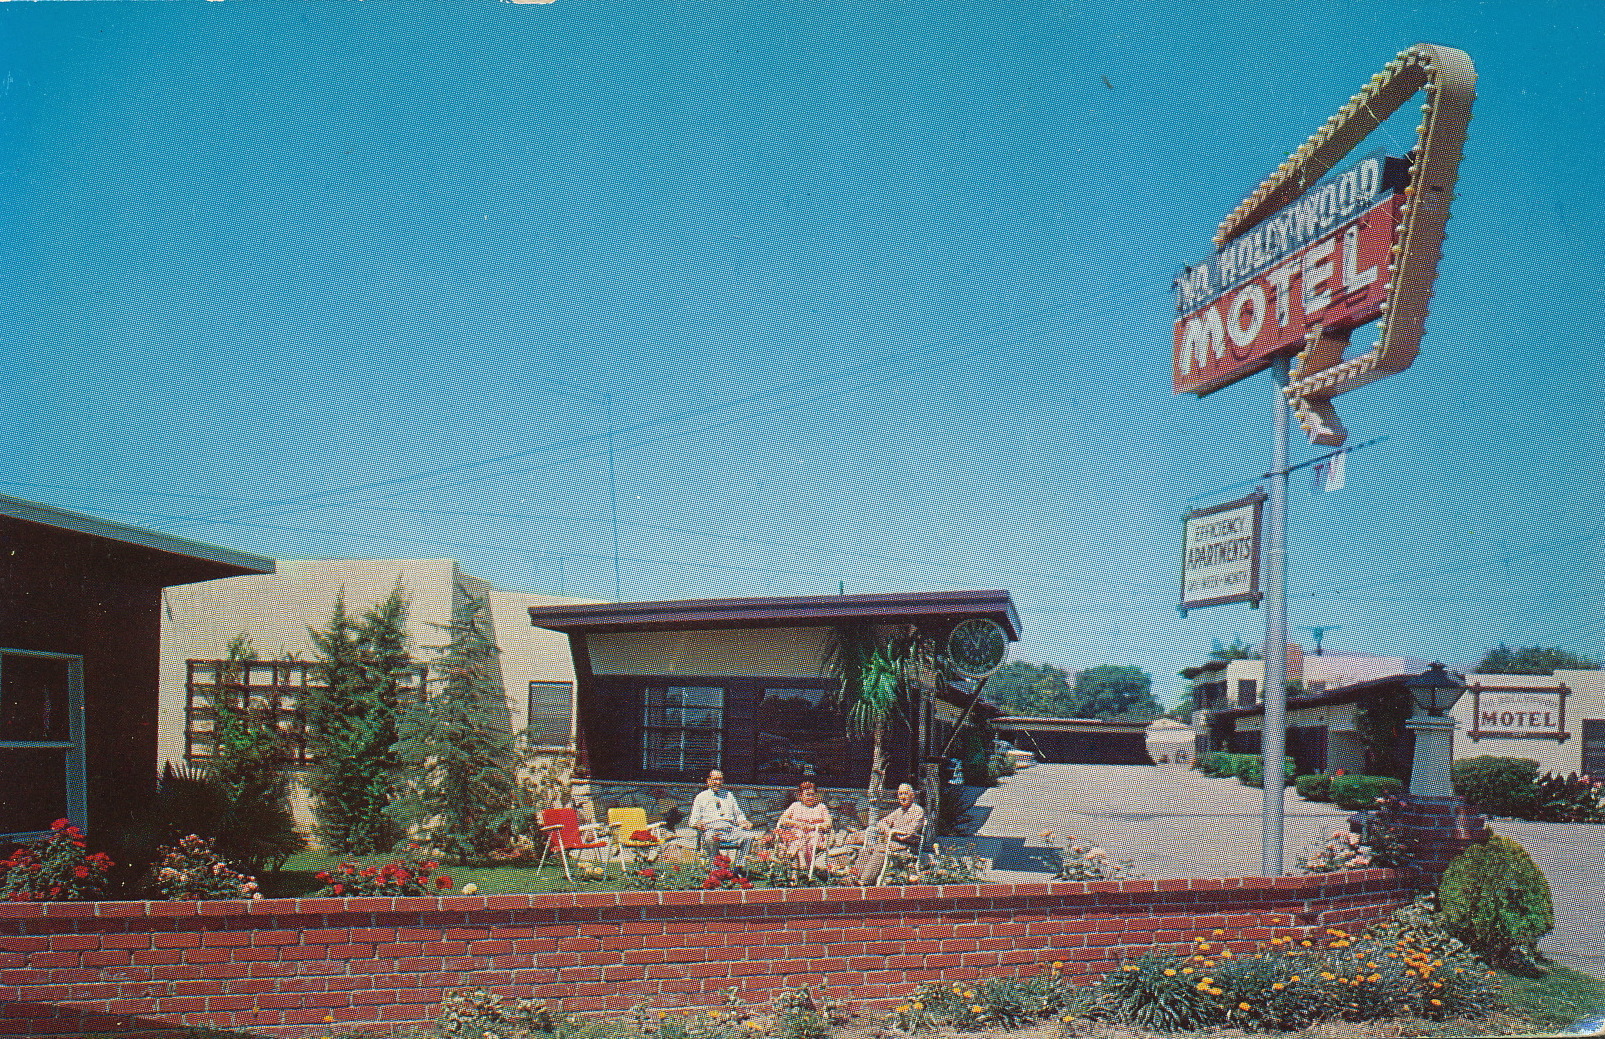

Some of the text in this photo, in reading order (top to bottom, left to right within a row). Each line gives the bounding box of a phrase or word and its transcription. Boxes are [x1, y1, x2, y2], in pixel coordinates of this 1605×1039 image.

[1220, 158, 1379, 288] HOLLYWOOD
[1179, 225, 1378, 376] MOTEL
[1195, 516, 1245, 542] EFFICIENCY
[1187, 536, 1252, 570] APARTMENTS
[1481, 710, 1556, 727] MOTEL
